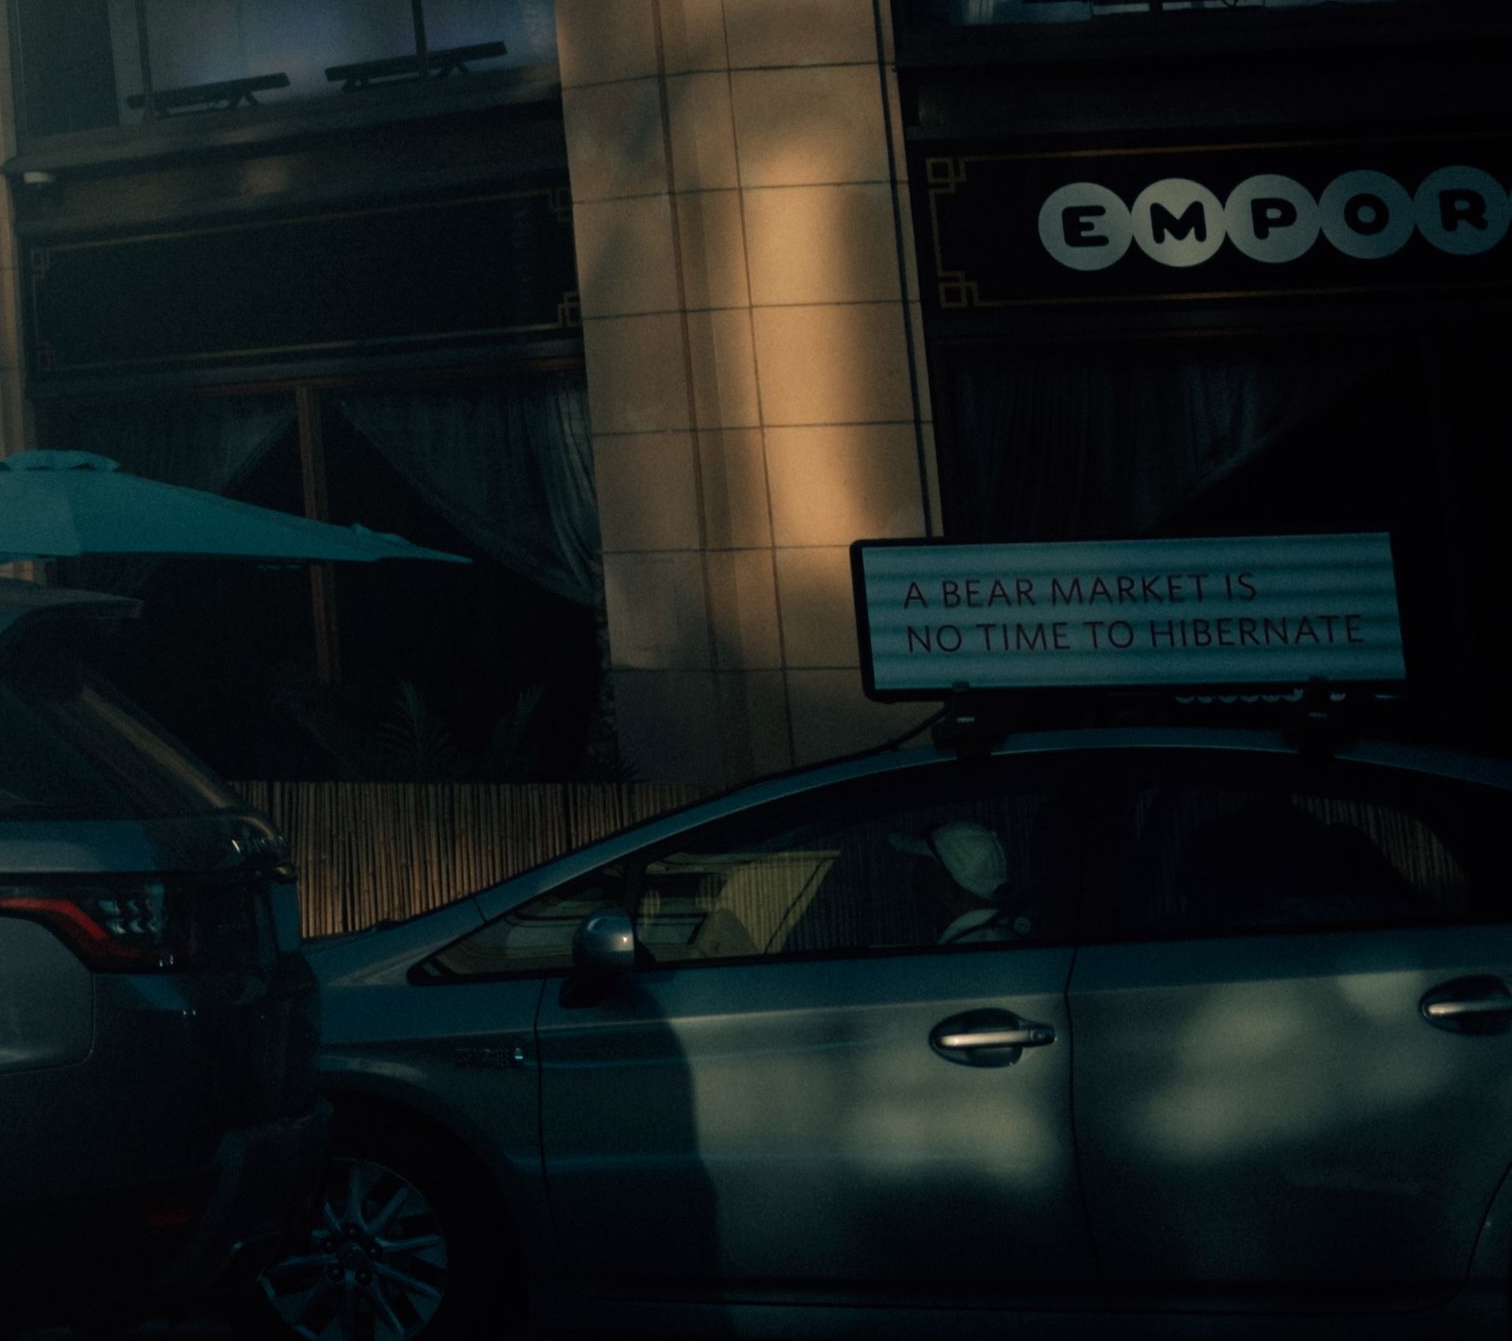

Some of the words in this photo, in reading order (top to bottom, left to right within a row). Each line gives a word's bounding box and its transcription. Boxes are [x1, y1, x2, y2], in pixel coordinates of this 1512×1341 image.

[1060, 187, 1490, 248] EMPOR
[903, 581, 928, 609] A
[942, 579, 1037, 608] BEAR
[1052, 573, 1210, 606] MARKET
[1225, 572, 1258, 602] IS
[907, 624, 963, 654] NO
[977, 621, 1071, 652] TIME
[1083, 620, 1134, 650] TO
[1151, 614, 1366, 648] HIBERNATE
